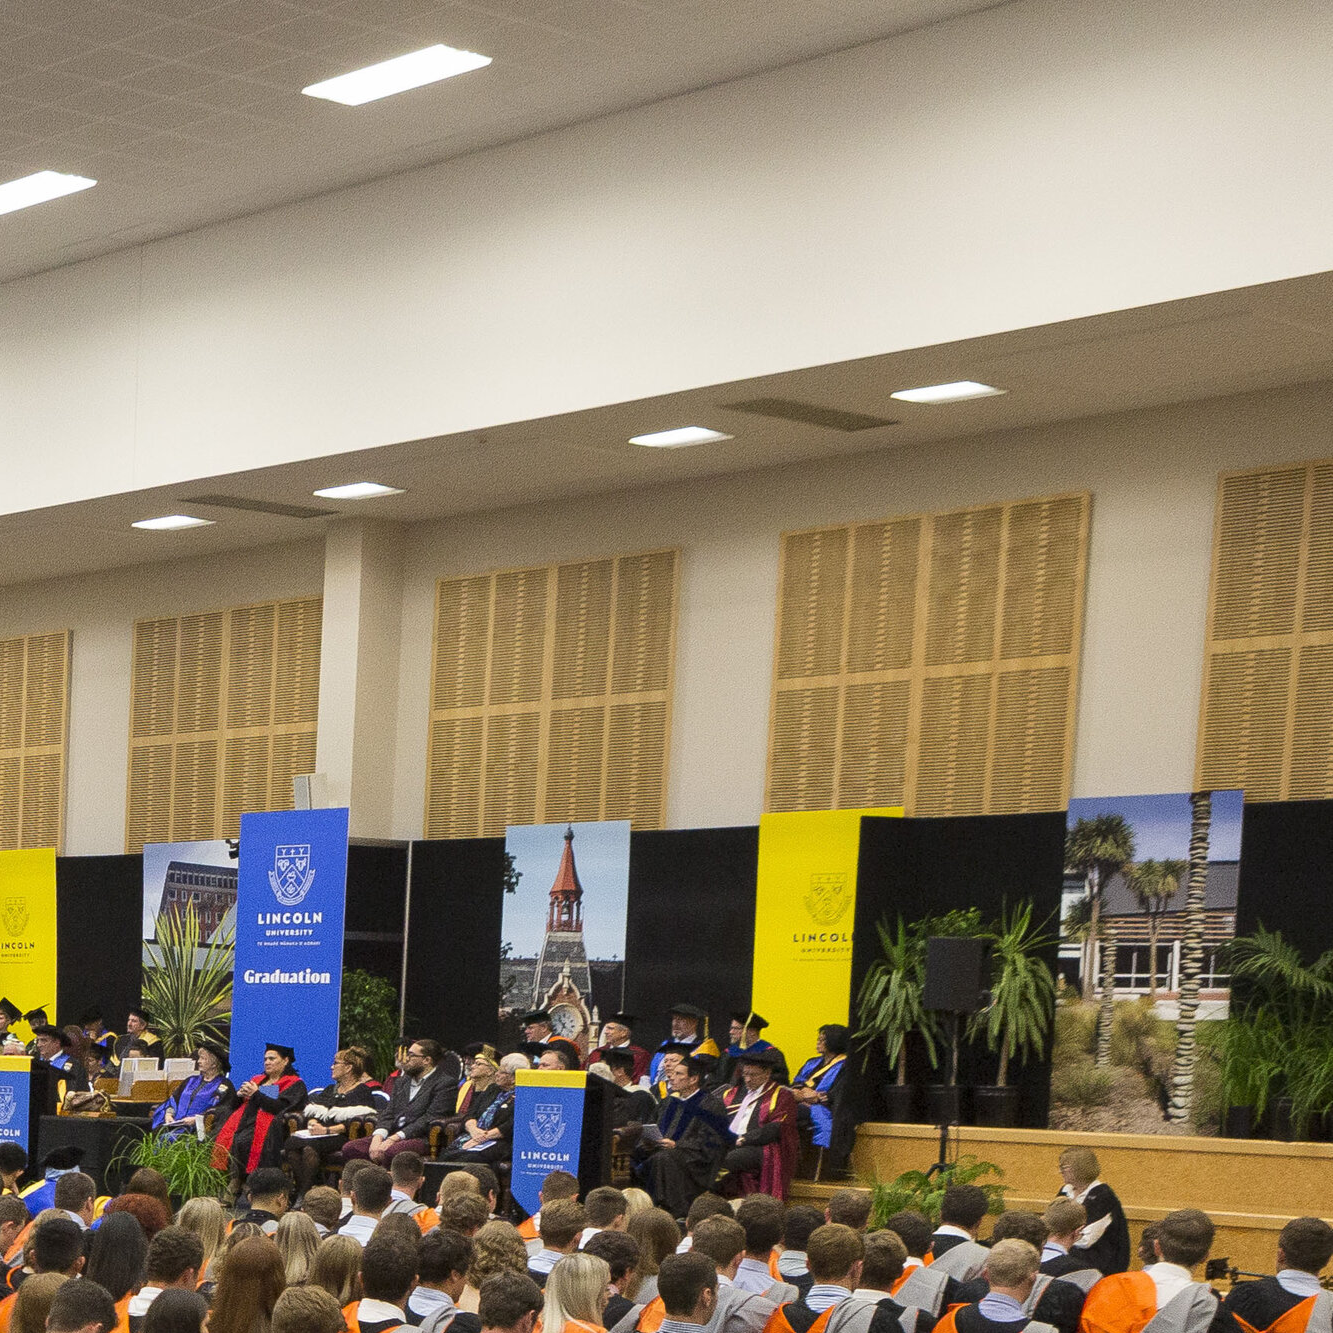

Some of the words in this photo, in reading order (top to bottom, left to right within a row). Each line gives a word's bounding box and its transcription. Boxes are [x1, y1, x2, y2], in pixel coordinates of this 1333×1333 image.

[257, 912, 323, 925] LINCOLN
[265, 929, 313, 937] UNIVERSITY
[793, 932, 854, 943] LINCOL
[243, 968, 331, 984] Graduation
[520, 1151, 570, 1162] LINCOLN
